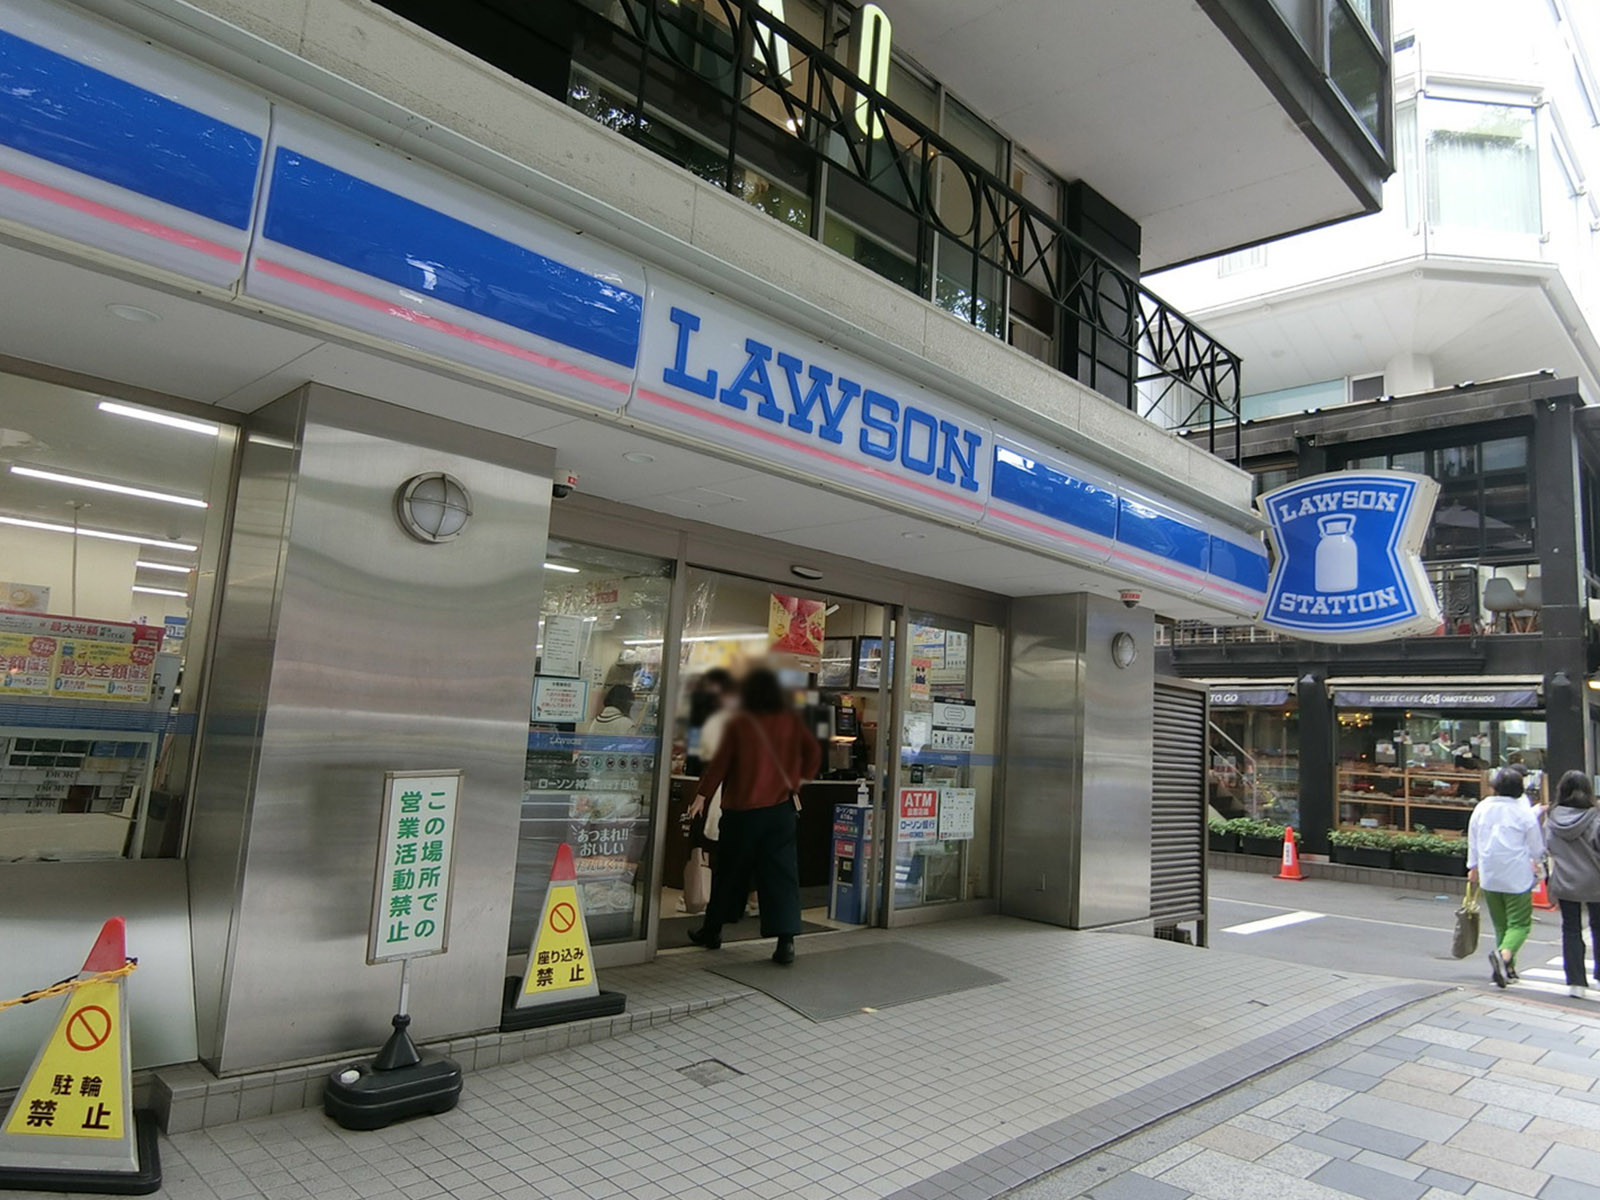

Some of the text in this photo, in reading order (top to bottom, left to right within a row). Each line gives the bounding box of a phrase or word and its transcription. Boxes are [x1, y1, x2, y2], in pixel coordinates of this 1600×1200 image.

[663, 306, 982, 492] LAWSON
[1279, 490, 1399, 523] LAWSON
[1279, 586, 1399, 615] STATION
[1209, 694, 1238, 702] TO GO
[904, 792, 933, 807] ATM
[900, 820, 935, 830] ローソン銀行
[580, 842, 624, 856] おいしい
[386, 790, 422, 943] 営業活動禁止
[414, 791, 446, 938] この場所での
[537, 947, 584, 965] 座り込み
[51, 1074, 103, 1097] 駐輪
